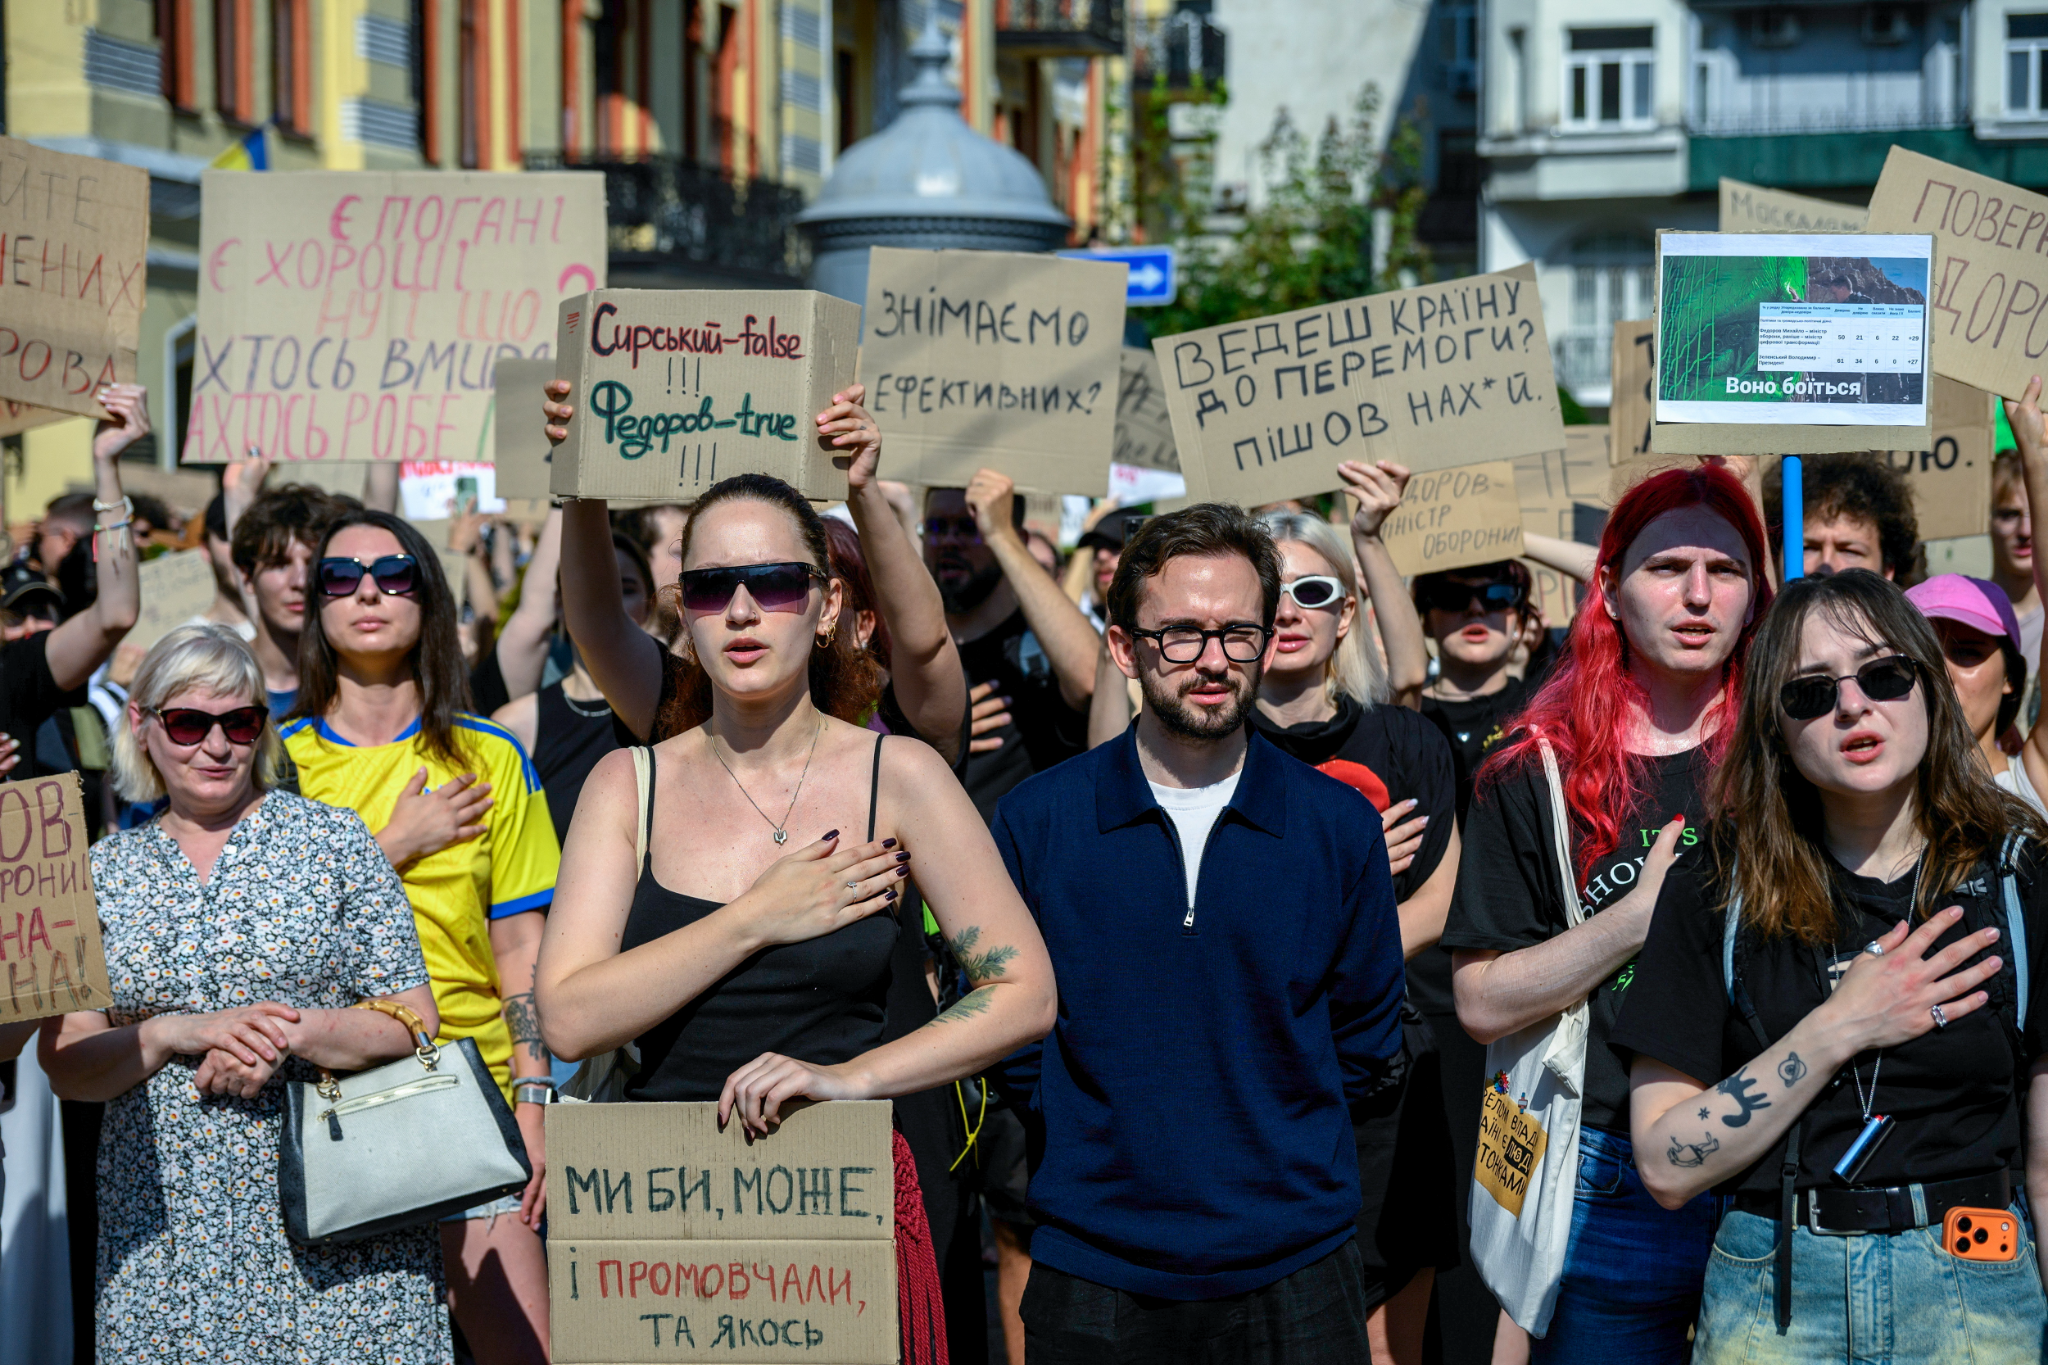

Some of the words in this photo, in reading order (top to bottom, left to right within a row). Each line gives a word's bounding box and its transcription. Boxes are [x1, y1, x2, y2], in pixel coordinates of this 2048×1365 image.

[329, 193, 362, 241] Є
[374, 193, 566, 246] ПОГАНІ
[207, 237, 243, 294] Є
[255, 238, 470, 292] ХОРОШІ
[194, 334, 355, 393] ХТОСЬ
[1174, 305, 1372, 390] ВЕДЕШ
[1391, 281, 1521, 336] КРАЇНУ
[873, 373, 1102, 420] ЕФЕКТИВНИХ?
[1196, 374, 1257, 428] ДО
[1274, 318, 1535, 400] ПЕРЕМОГИ?
[1726, 376, 1777, 395] Воно
[1782, 376, 1862, 396] боїться
[1233, 402, 1389, 471] ПІШОВ
[565, 1165, 633, 1216] МИ
[647, 1166, 724, 1221] БИ,
[733, 1164, 884, 1226] МОЖЕ,
[596, 1259, 867, 1317] ПРОМОВЧАЛИ,
[639, 1313, 696, 1349] ТА
[709, 1314, 824, 1350] ЯКОСЬ
